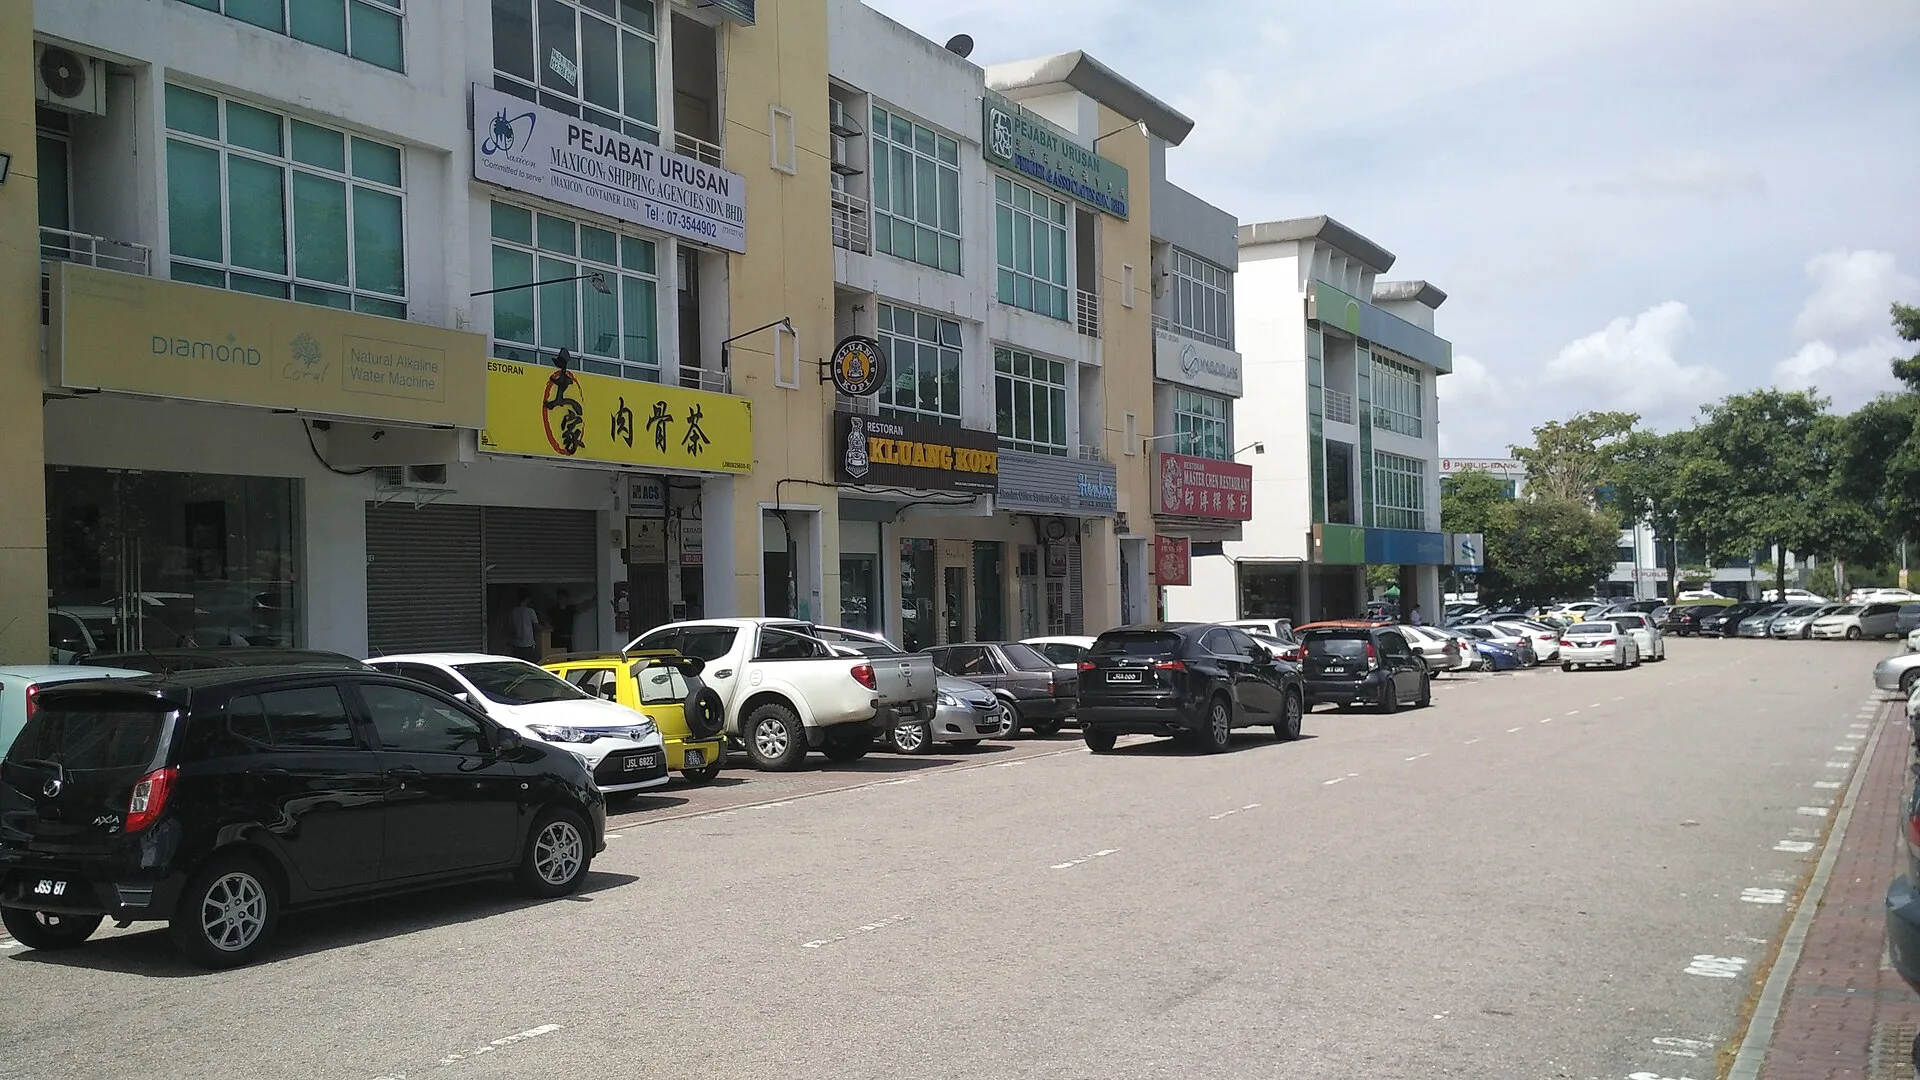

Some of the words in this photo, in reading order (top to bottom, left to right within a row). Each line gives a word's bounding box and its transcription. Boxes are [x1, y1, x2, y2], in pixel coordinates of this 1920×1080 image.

[1015, 118, 1058, 152] PEJABAT
[1061, 142, 1100, 173] URUSAN
[568, 124, 653, 171] PEJABAT
[660, 156, 729, 197] URUSAN
[519, 169, 526, 179] to
[551, 175, 583, 193] (MAXICON
[585, 185, 621, 205] CONTAINER
[622, 196, 639, 211] LINE)
[608, 164, 655, 195] SHIPPING
[657, 182, 704, 211] AGENCIES
[706, 197, 724, 217] SDN.
[725, 202, 744, 223] BHD.
[645, 203, 659, 221] Tel
[667, 210, 717, 238] 07-3544902
[351, 348, 393, 367] Natural
[397, 354, 438, 373] Alkaline
[837, 343, 875, 364] KLUANG
[282, 361, 330, 384] Coral
[350, 366, 384, 384] Water
[389, 371, 435, 390] Machine
[487, 361, 524, 376] ESTORAN
[842, 379, 870, 391] KOPI
[610, 397, 711, 457] 肉骨茶
[867, 421, 903, 436] RESTORAN
[867, 437, 953, 470] KLUANG
[954, 447, 998, 474] KOPI
[1183, 461, 1205, 472] RESTORAN
[1183, 470, 1205, 487] MASTER
[1205, 473, 1219, 488] CHEN
[1219, 474, 1250, 492] RESTAURANT
[643, 485, 660, 500] ACS
[626, 759, 638, 768] JSL
[639, 756, 654, 767] 6822
[92, 814, 120, 826] AXIA
[34, 879, 53, 895] JSS
[53, 881, 67, 896] 87
